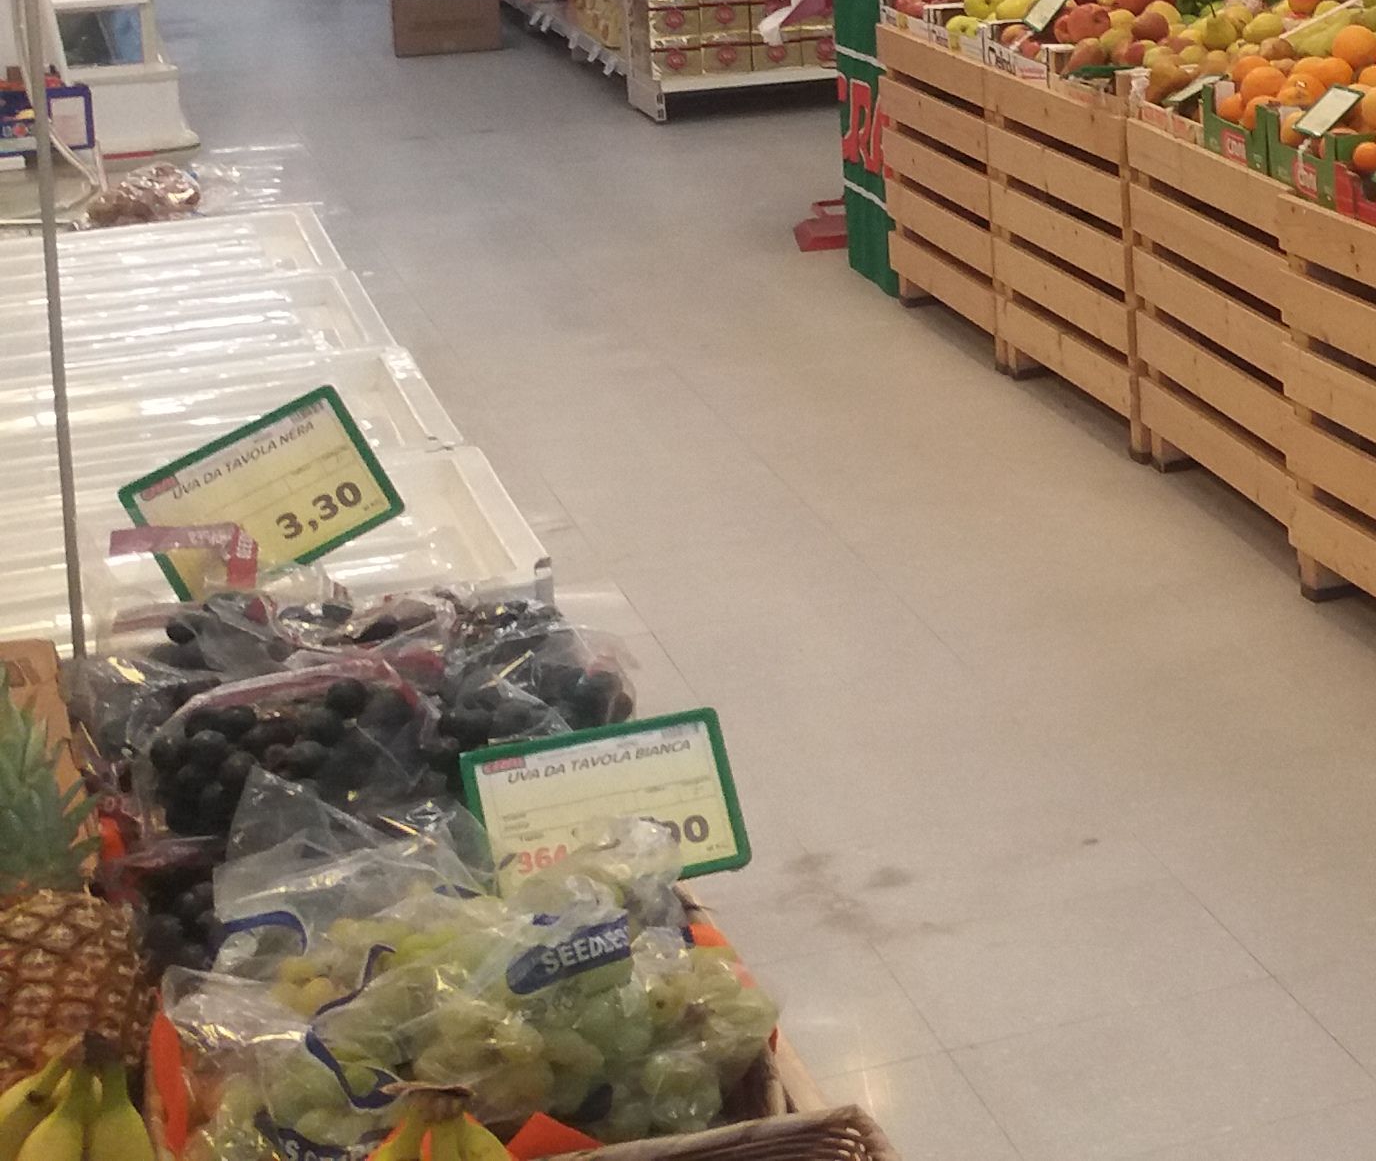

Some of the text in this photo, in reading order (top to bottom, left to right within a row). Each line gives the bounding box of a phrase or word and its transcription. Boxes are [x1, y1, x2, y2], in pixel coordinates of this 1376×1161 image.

[172, 478, 201, 501] UVA
[204, 469, 223, 485] DA
[225, 441, 277, 473] TAVOLA
[279, 421, 315, 446] NERA
[275, 481, 363, 540] 3,30
[507, 739, 692, 785] UVA DA TAVOLA BIANCA
